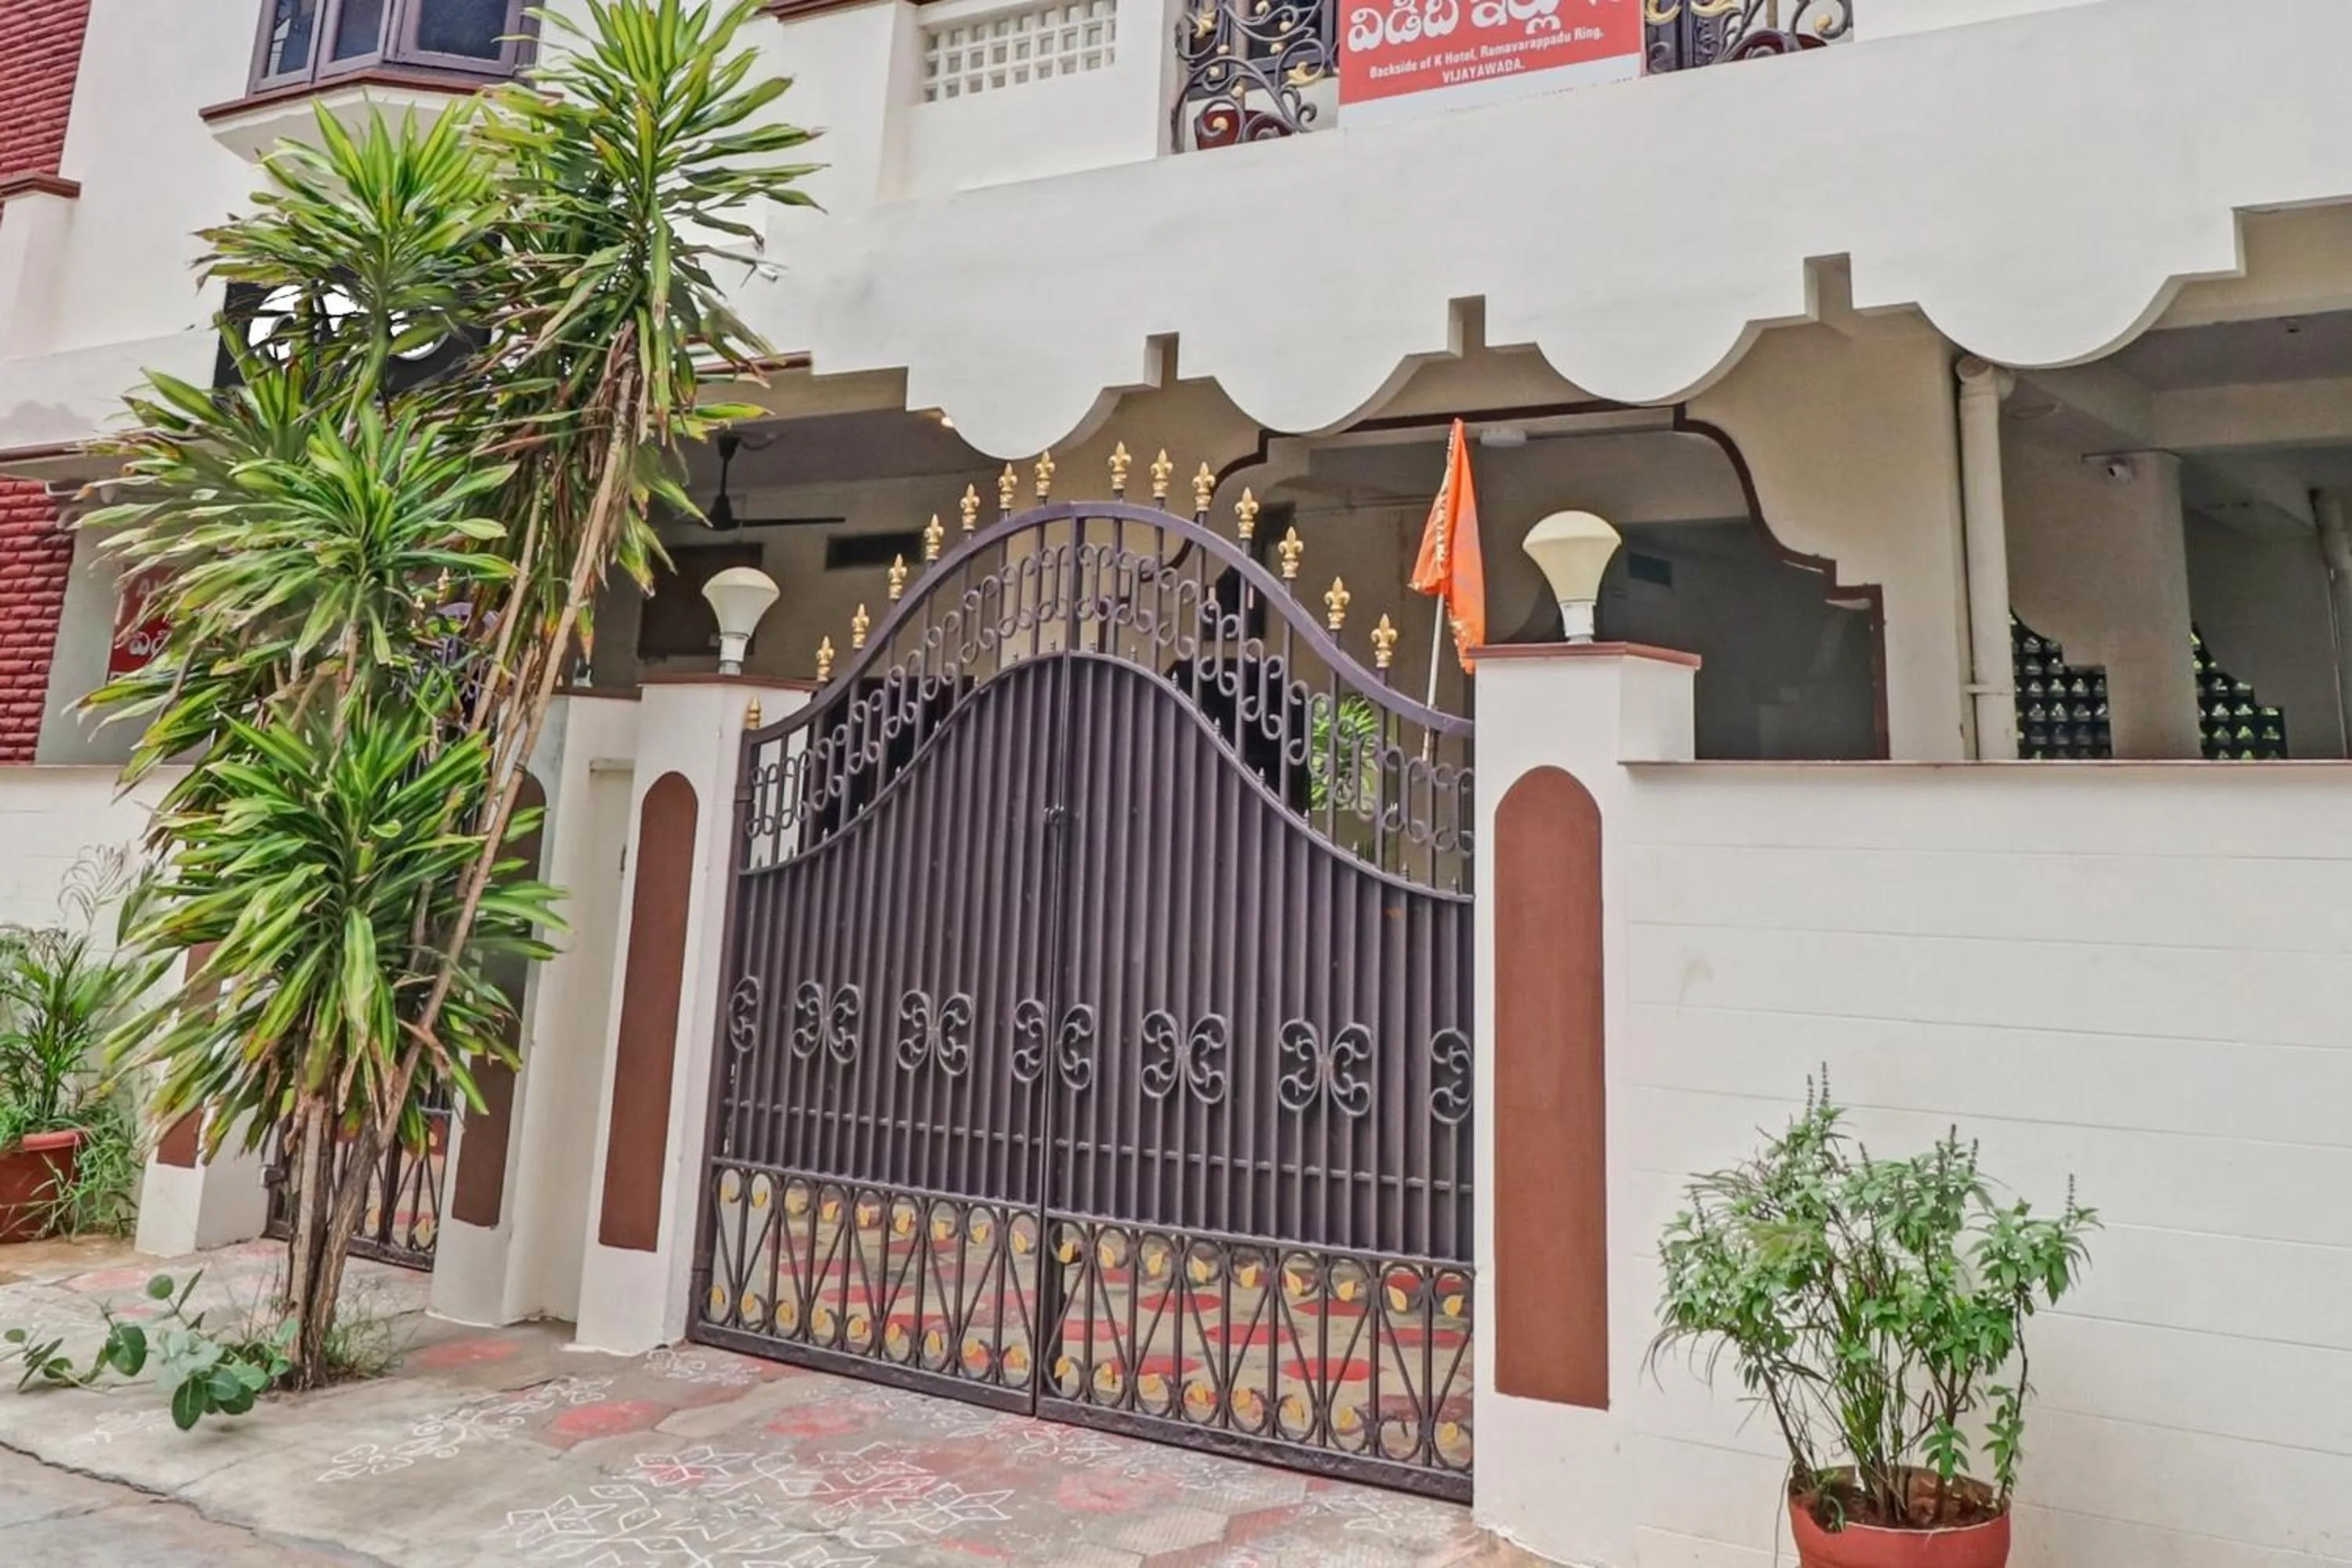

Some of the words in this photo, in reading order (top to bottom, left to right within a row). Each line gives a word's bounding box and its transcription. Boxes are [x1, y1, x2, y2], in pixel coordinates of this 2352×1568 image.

[1369, 60, 1417, 78] Backside
[1420, 55, 1431, 69] of
[1433, 54, 1443, 67] K
